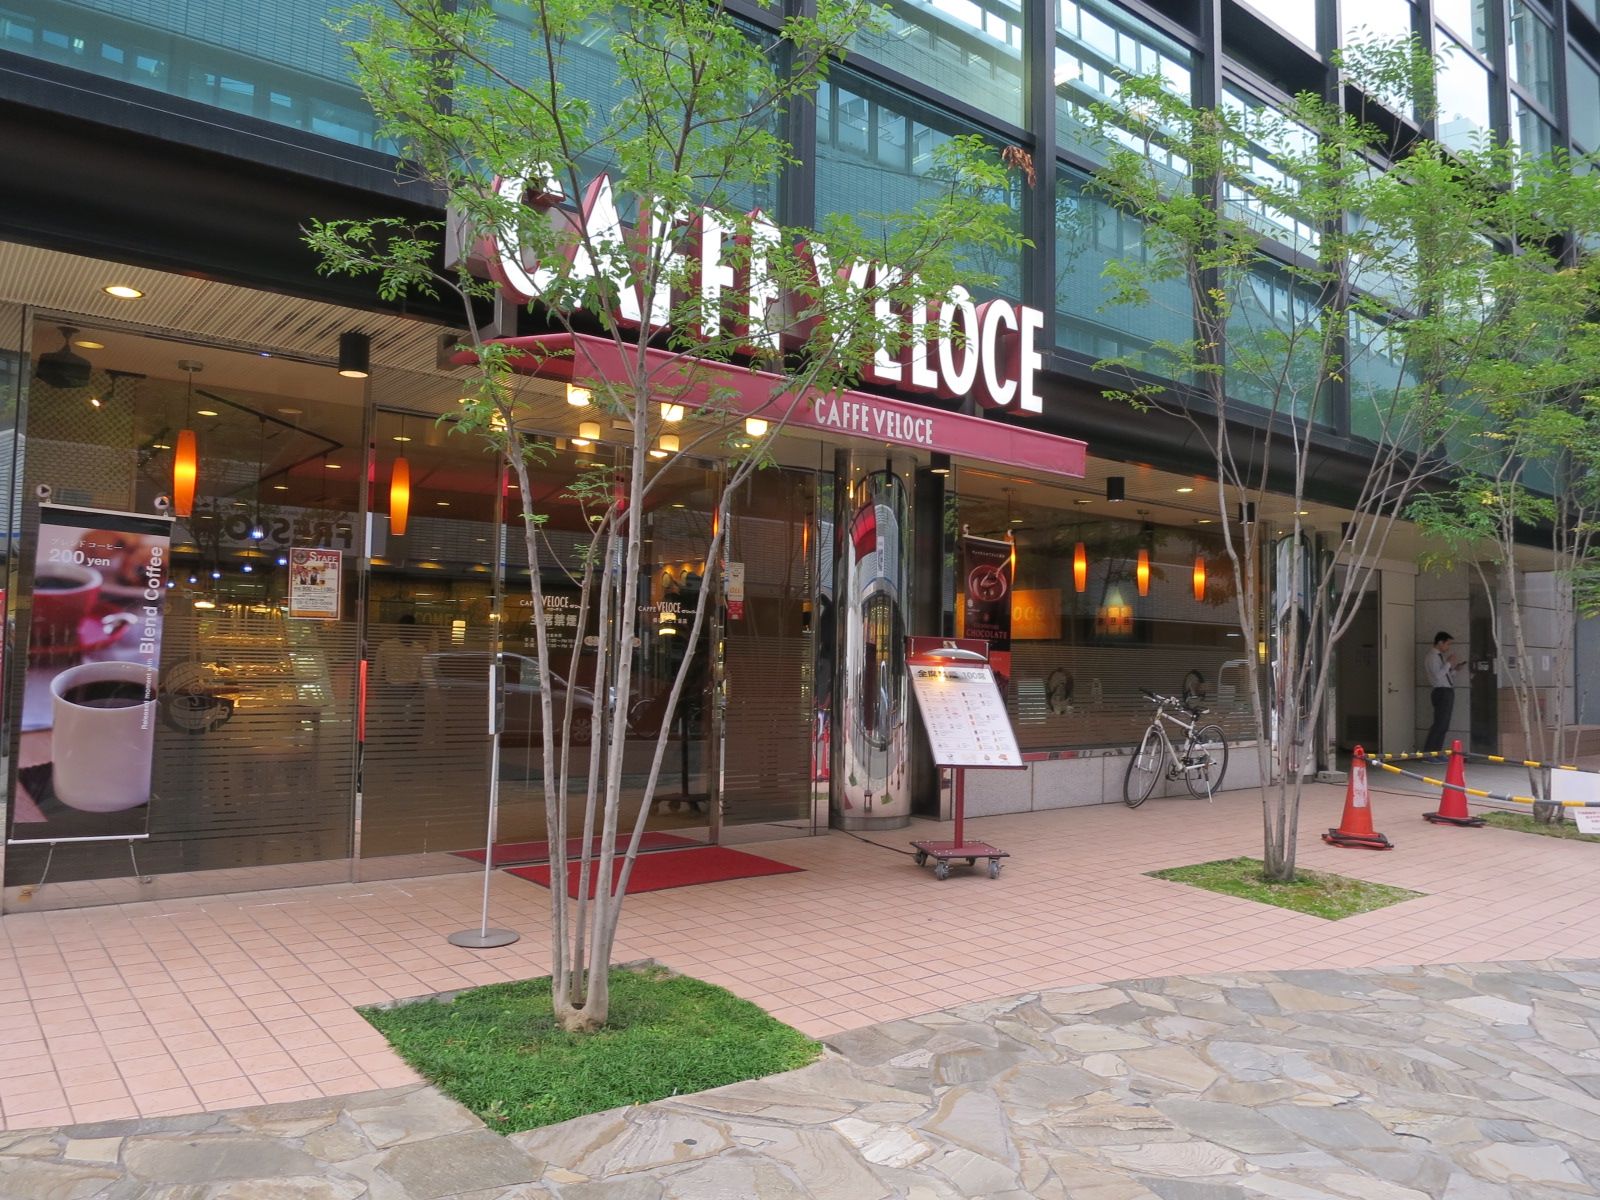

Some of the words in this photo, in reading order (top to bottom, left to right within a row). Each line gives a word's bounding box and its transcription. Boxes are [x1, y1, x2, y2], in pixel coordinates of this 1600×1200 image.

[809, 241, 1045, 414] VELOCE
[872, 407, 933, 445] VELOCE
[48, 548, 85, 565] 200
[87, 556, 111, 567] yen
[144, 546, 163, 601] Coffee
[541, 595, 569, 608] VELOCE
[656, 601, 681, 613] VELOCE
[139, 606, 158, 654] Blend
[144, 674, 152, 699] moment
